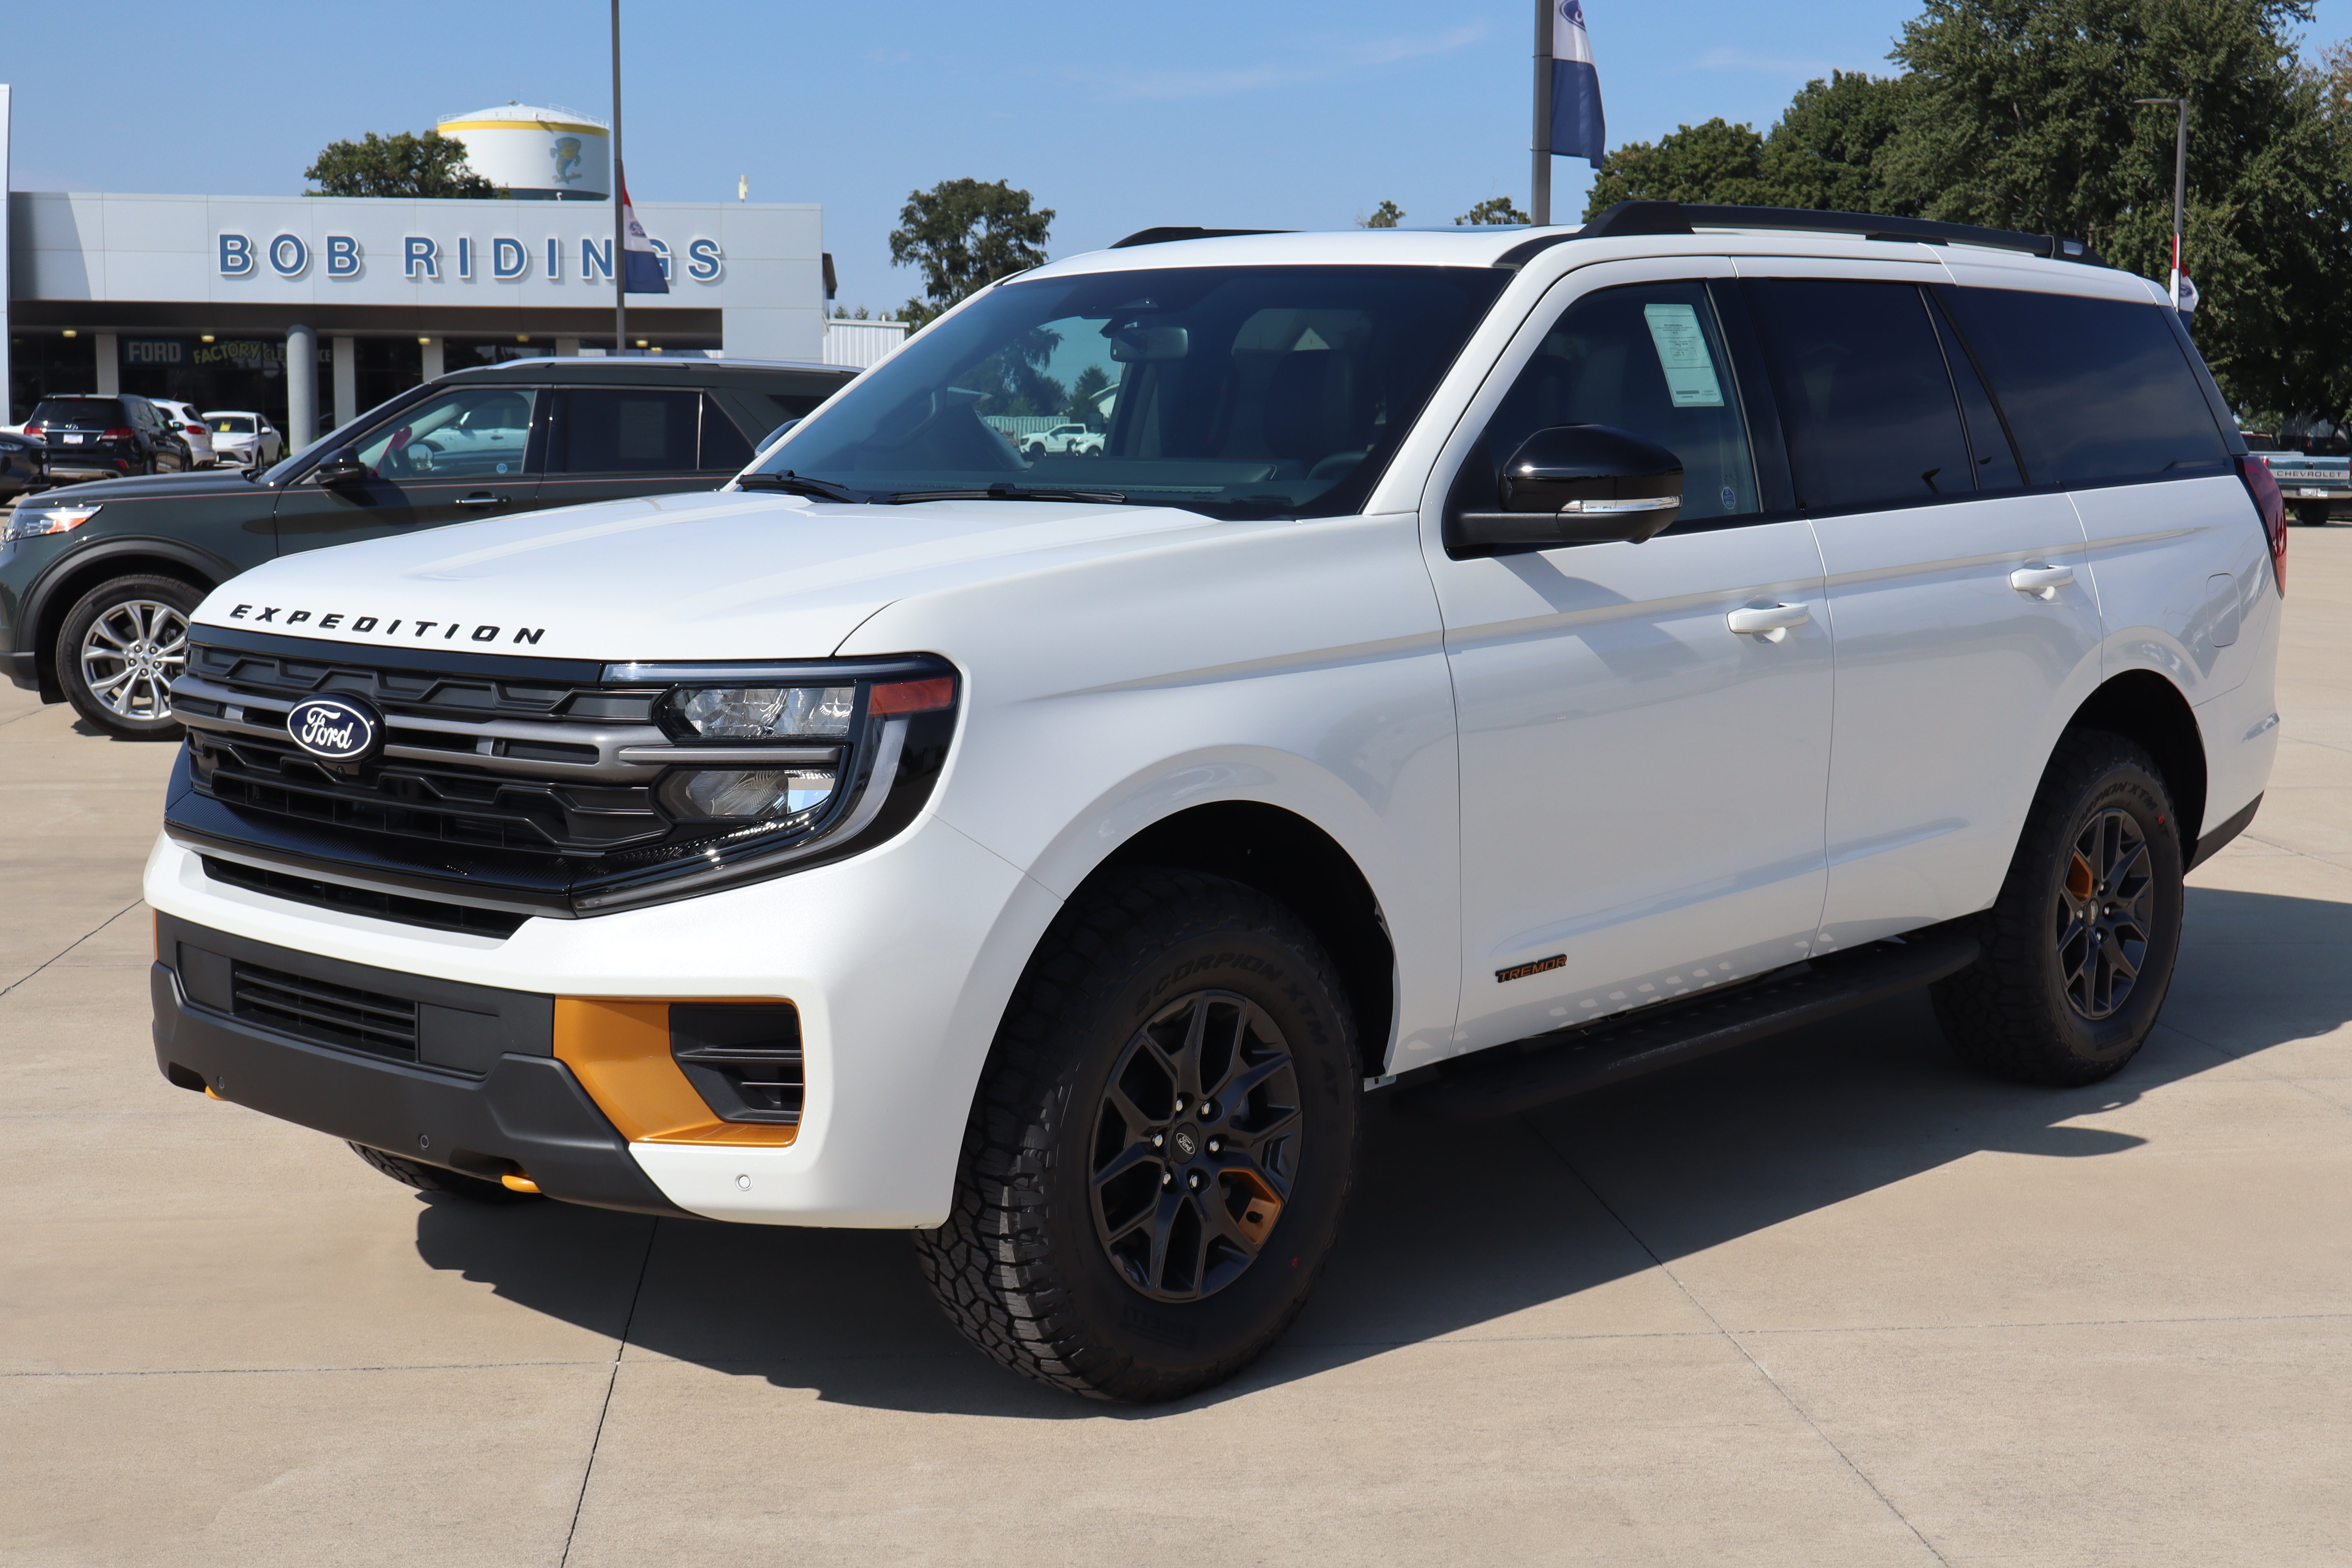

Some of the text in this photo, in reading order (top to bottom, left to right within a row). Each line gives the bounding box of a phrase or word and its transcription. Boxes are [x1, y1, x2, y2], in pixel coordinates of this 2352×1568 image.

[219, 232, 361, 277] BOB
[128, 341, 182, 363] FORD
[193, 342, 332, 364] FACTORY CLECE
[2276, 470, 2342, 478] CHEVROLET
[229, 604, 546, 645] EXPEDITION
[302, 707, 354, 750] Ford
[1496, 954, 1567, 982] TREMOR
[1134, 952, 1284, 1017] SCORPION
[1281, 982, 1330, 1045] XTM
[1178, 1136, 1193, 1152] Ford
